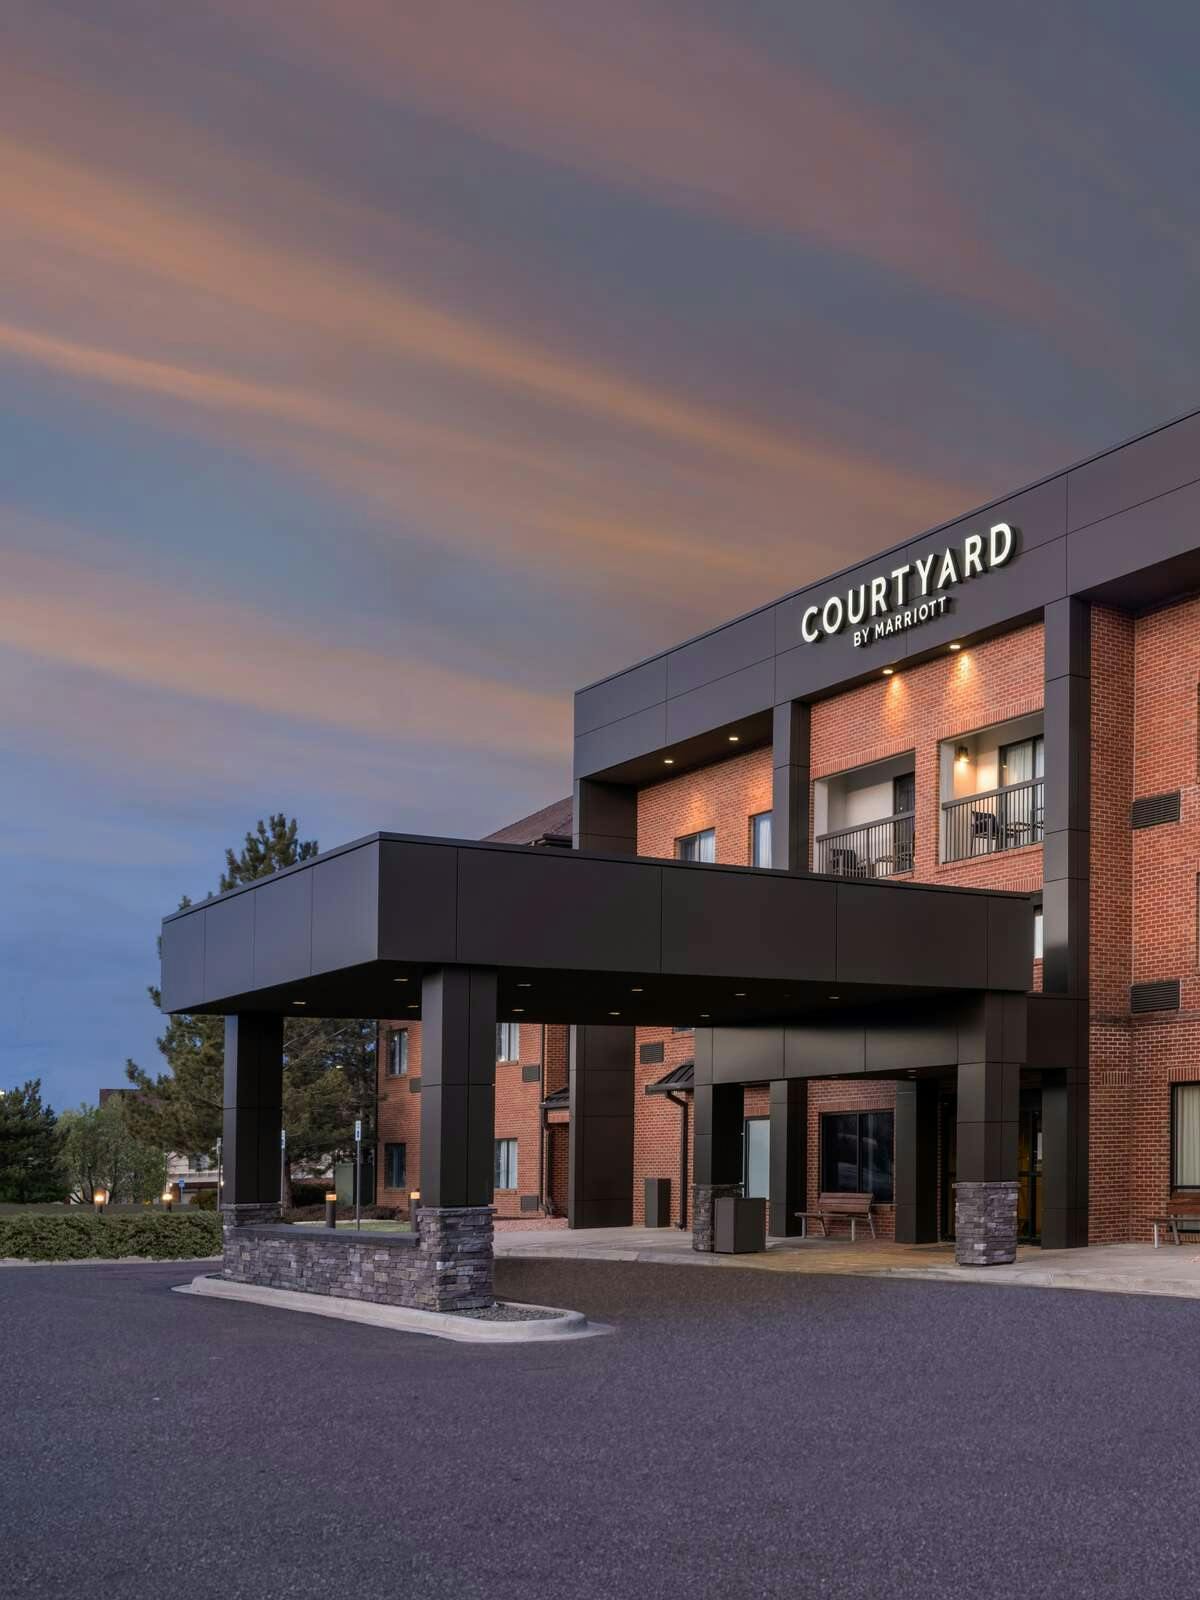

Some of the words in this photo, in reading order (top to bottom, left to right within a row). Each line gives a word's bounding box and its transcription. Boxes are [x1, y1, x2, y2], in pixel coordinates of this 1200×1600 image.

[801, 522, 1012, 643] COURTYARD
[853, 629, 870, 647] BY
[875, 596, 947, 640] MARRIOTT
